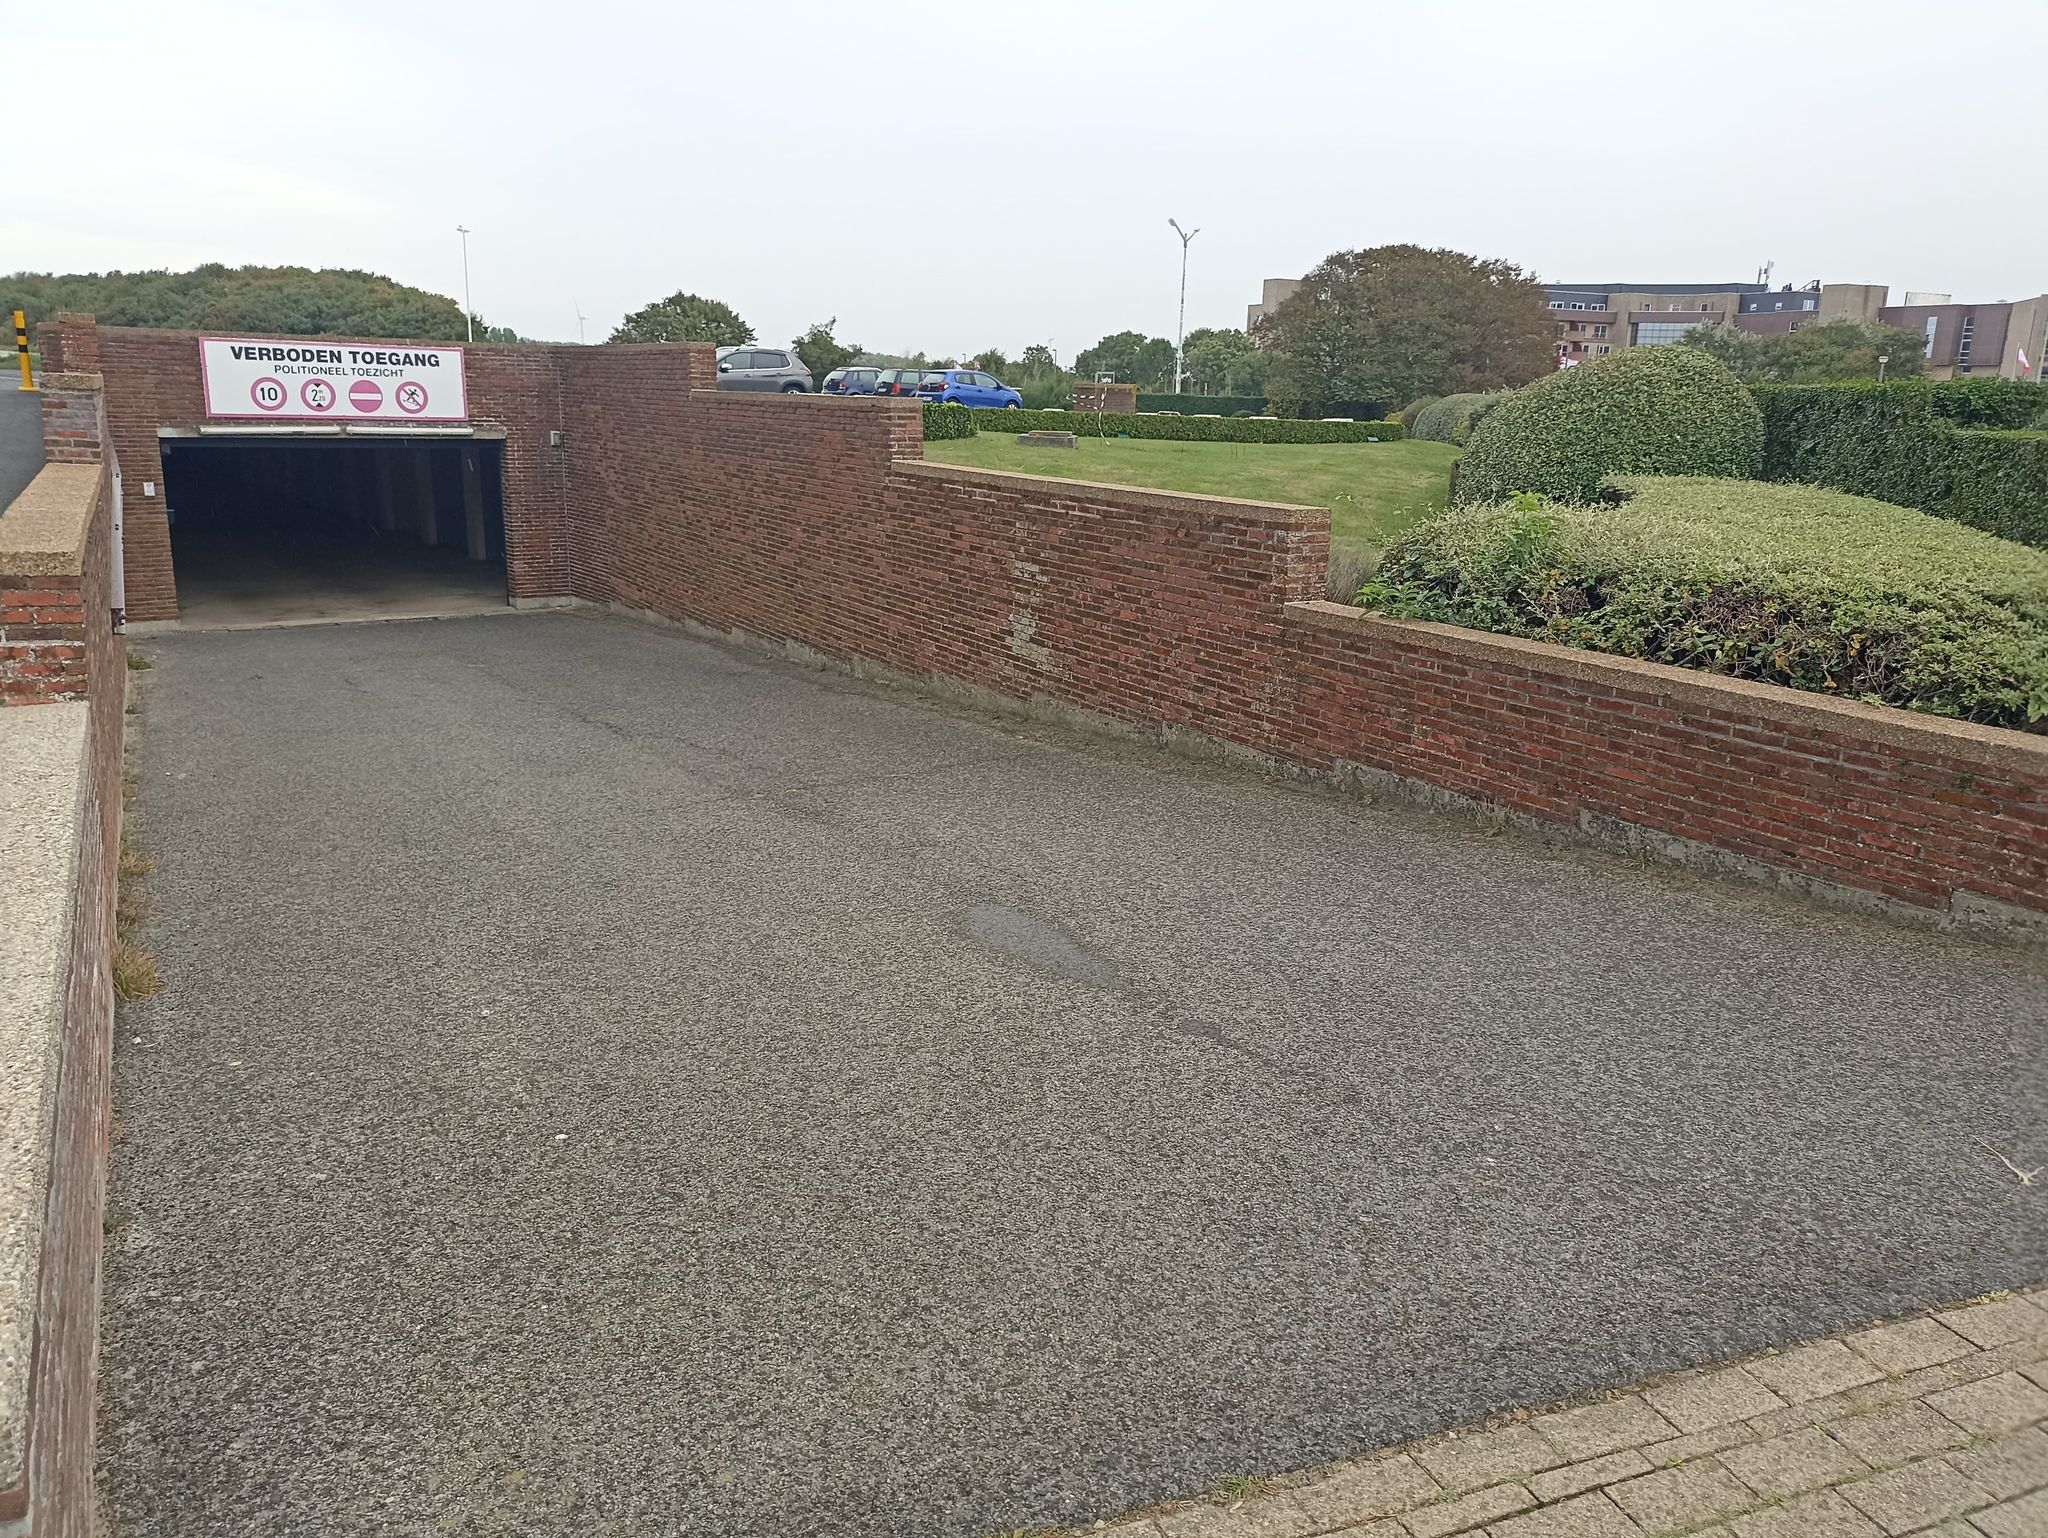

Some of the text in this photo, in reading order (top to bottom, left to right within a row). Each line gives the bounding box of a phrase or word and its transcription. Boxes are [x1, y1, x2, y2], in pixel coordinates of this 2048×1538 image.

[230, 345, 440, 367] VERBODEN TOEGANG
[274, 364, 404, 378] POLITIONEEL TOEZICHT
[259, 387, 278, 401] 10
